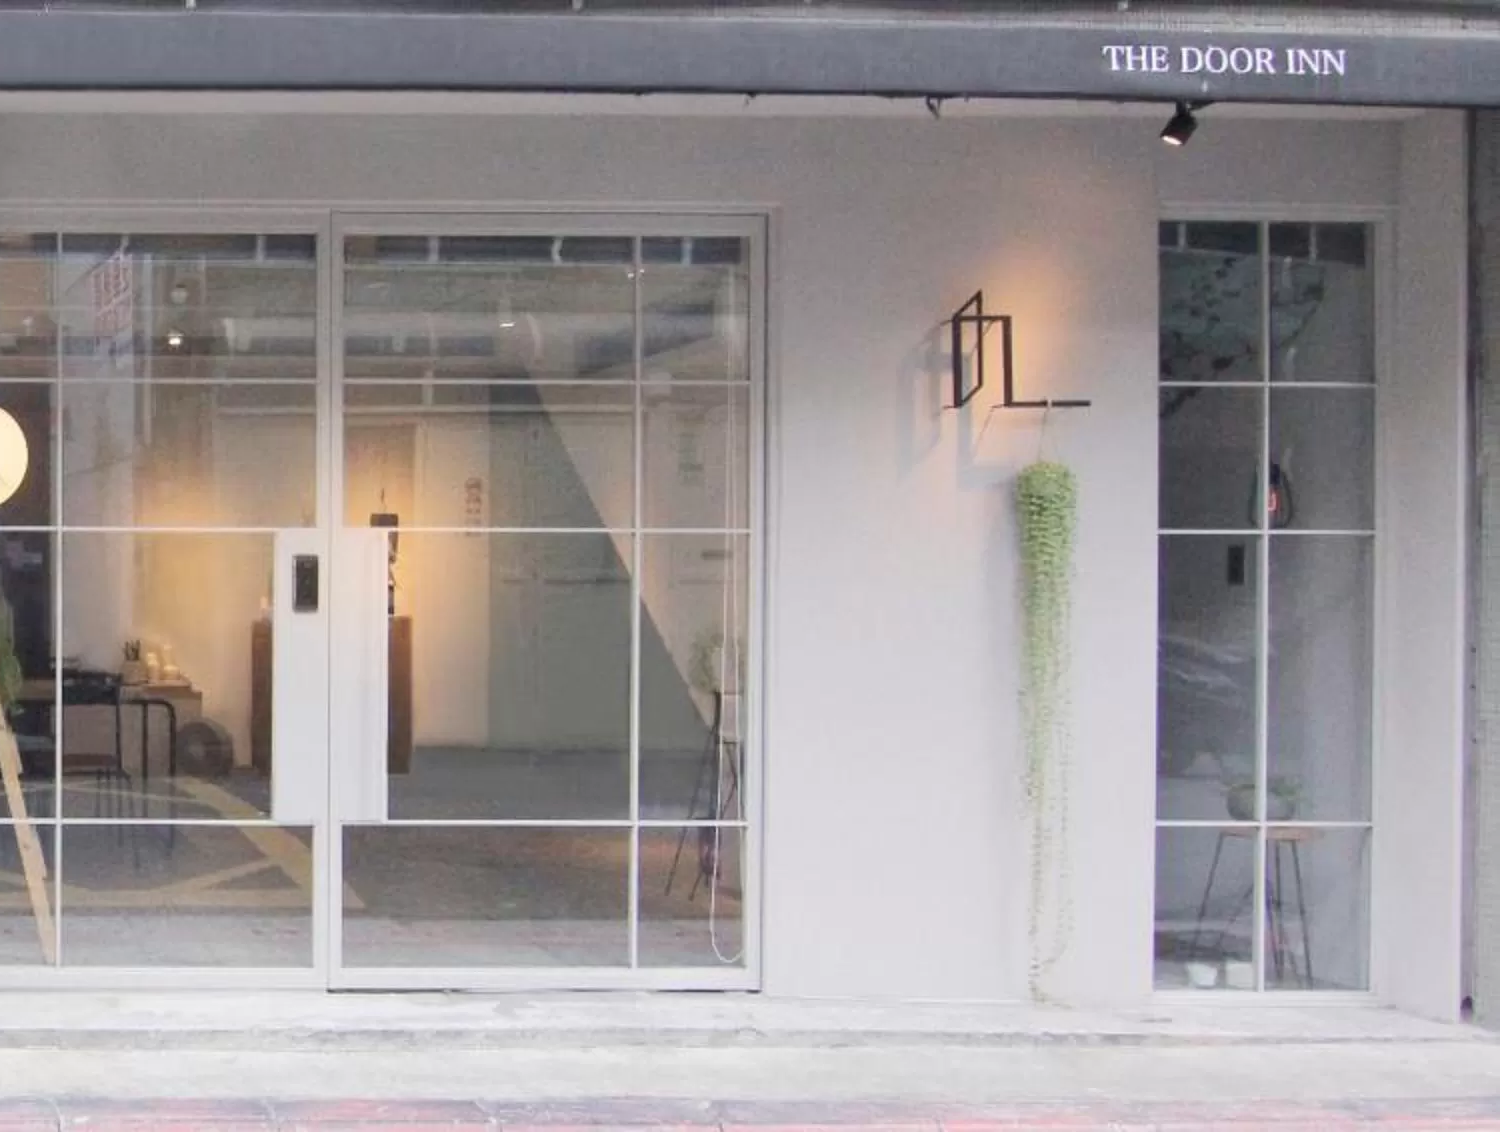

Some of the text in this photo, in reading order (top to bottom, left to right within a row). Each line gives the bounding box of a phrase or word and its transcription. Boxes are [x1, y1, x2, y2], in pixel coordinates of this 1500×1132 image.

[1102, 45, 1346, 76] THE DOOR INN
